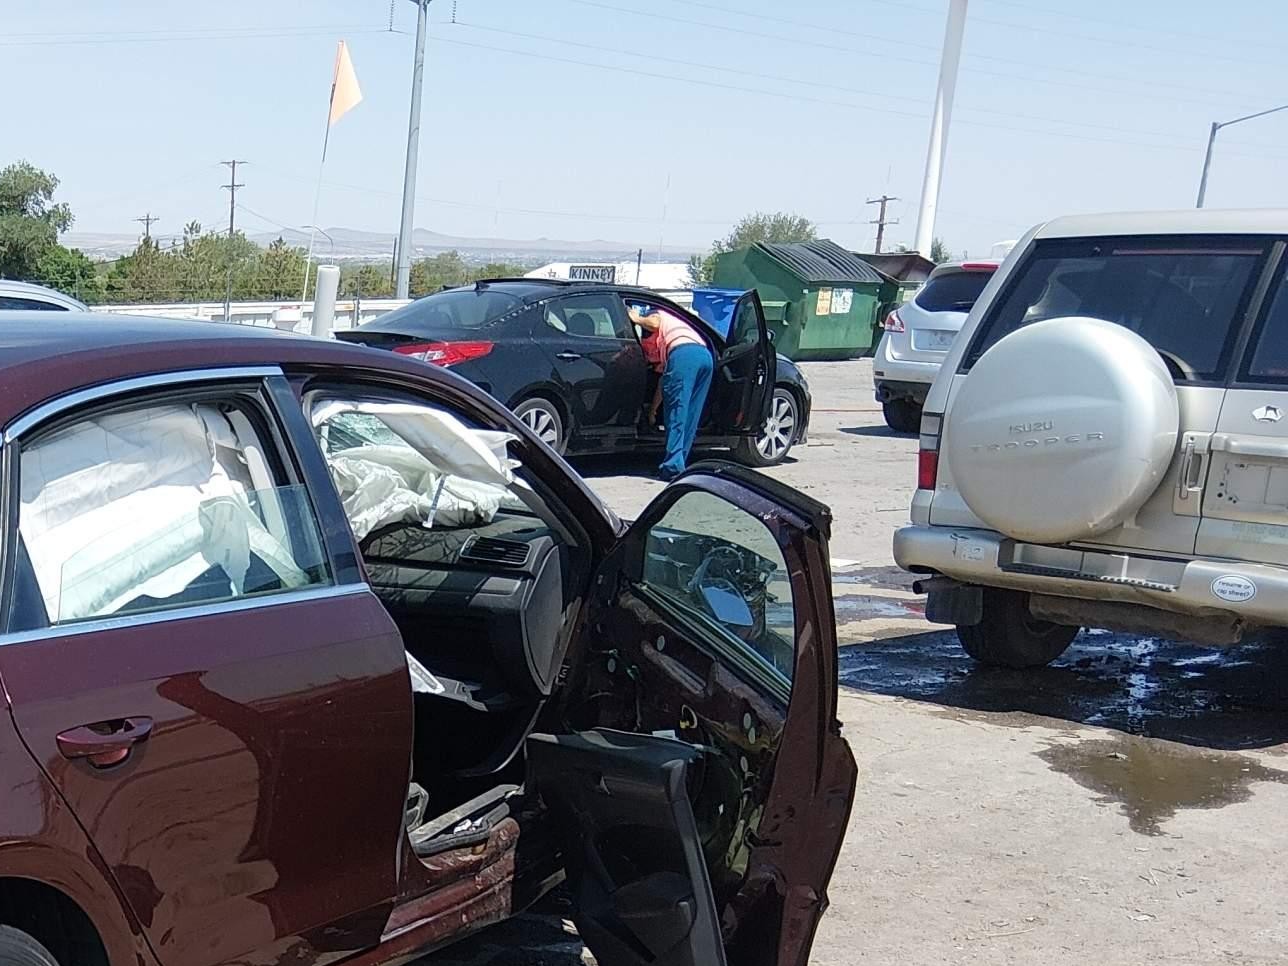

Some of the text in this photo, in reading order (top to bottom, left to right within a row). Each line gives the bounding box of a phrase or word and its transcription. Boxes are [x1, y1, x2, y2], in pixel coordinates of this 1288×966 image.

[571, 268, 613, 280] KINNEY
[1008, 421, 1054, 434] ISUZU
[969, 431, 1104, 452] TROOPER
